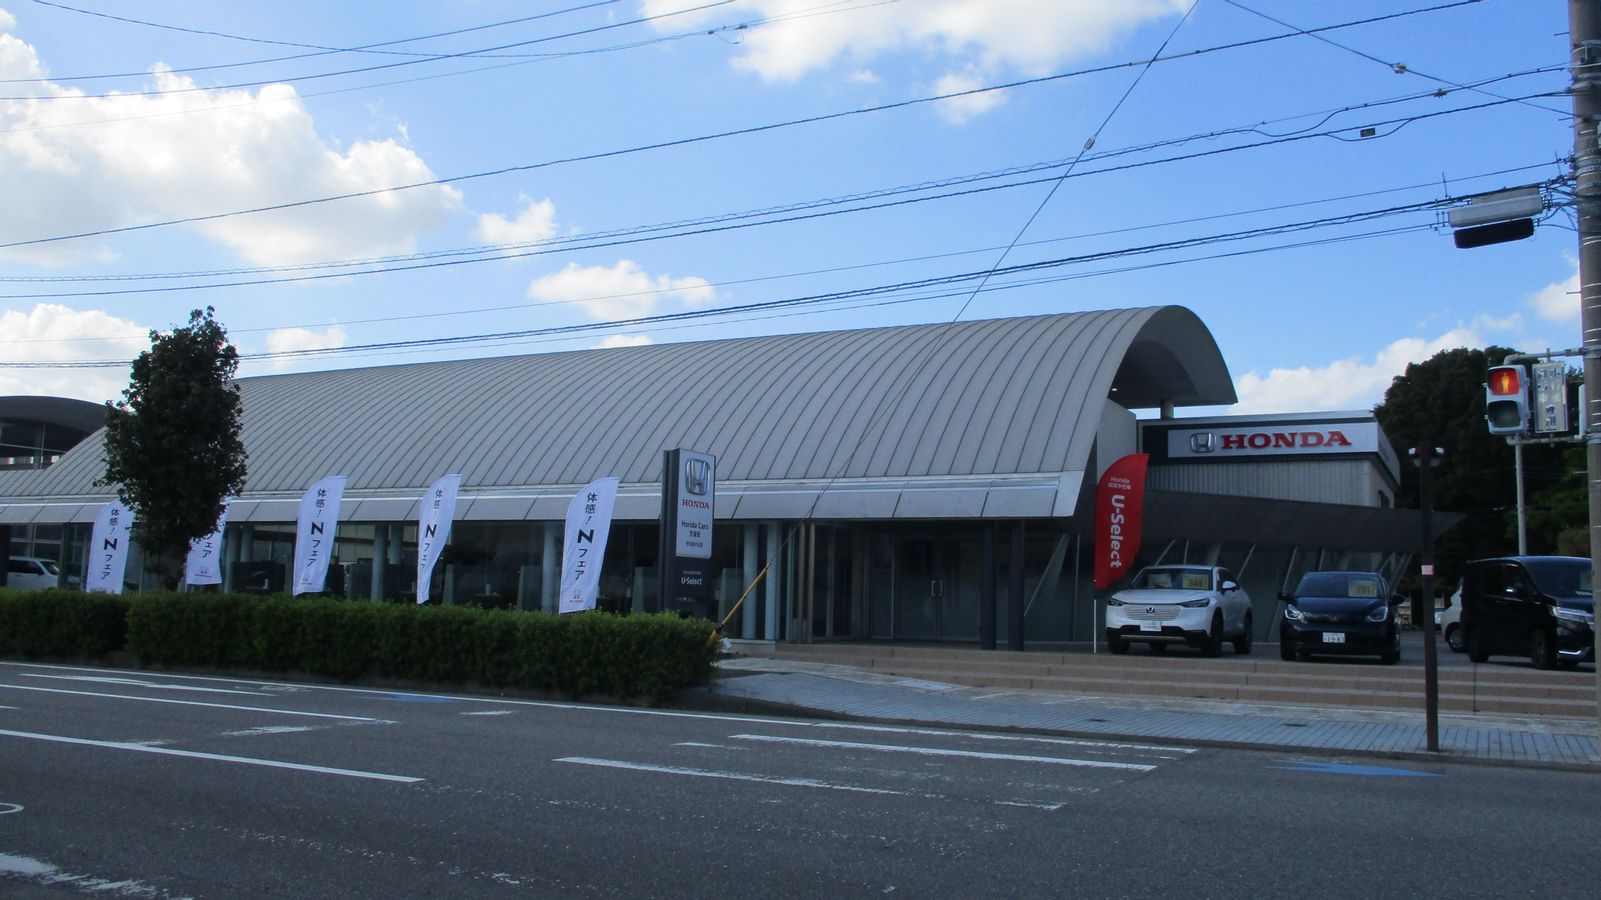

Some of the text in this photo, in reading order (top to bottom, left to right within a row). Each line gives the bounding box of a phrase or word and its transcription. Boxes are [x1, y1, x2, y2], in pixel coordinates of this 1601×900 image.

[1221, 430, 1352, 450] HONDA
[682, 498, 710, 510] HONDA
[681, 520, 697, 528] Honda
[1110, 494, 1126, 568] U-Select
[575, 491, 598, 580] 体感！Nフェア
[680, 576, 702, 585] U-Select
